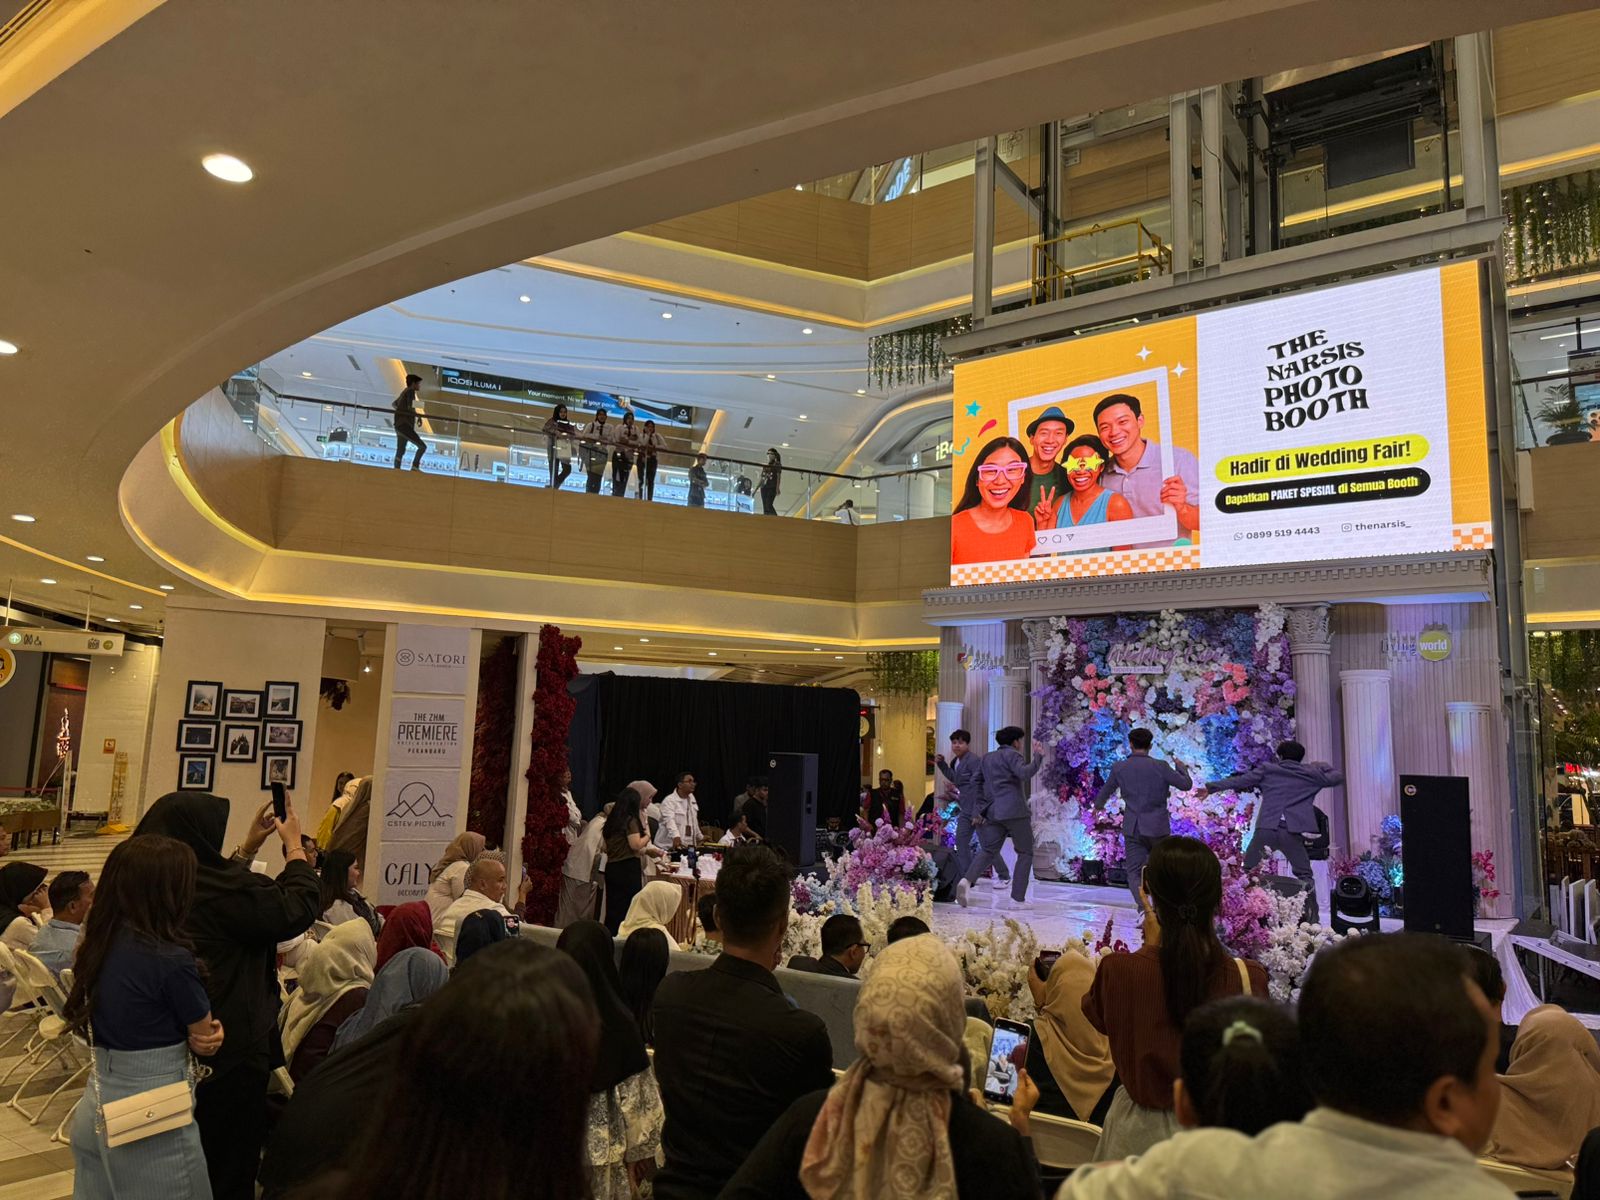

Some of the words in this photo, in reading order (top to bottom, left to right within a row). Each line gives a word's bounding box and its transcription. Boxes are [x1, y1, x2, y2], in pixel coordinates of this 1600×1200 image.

[1267, 329, 1329, 360] THE
[1266, 341, 1365, 381] NARSIS
[447, 376, 473, 387] IQOS
[473, 381, 497, 391] ILUMA
[1263, 364, 1363, 407] PHOTO
[527, 389, 541, 397] Your
[1263, 388, 1370, 432] BOOTH
[1230, 456, 1271, 477] Hadir
[1275, 454, 1290, 471] di
[1295, 447, 1368, 469] Wedding
[1373, 440, 1411, 460] Fair!
[1225, 491, 1270, 505] Dapatkan
[1271, 488, 1298, 500] PAKET
[1300, 484, 1337, 498] SPESIAL
[1338, 482, 1348, 494] di
[1350, 480, 1385, 493] Semua
[1387, 476, 1419, 489] Booth
[1246, 530, 1272, 540] 0899
[1274, 529, 1292, 538] 519
[1294, 526, 1321, 536] 4443
[1355, 520, 1412, 531] thenarsis_
[1420, 640, 1448, 650] world
[417, 652, 466, 665] SATORI
[413, 713, 427, 721] THE
[428, 713, 445, 722] ZHM
[397, 724, 458, 741] PREMIERE
[384, 862, 436, 886] CALY
